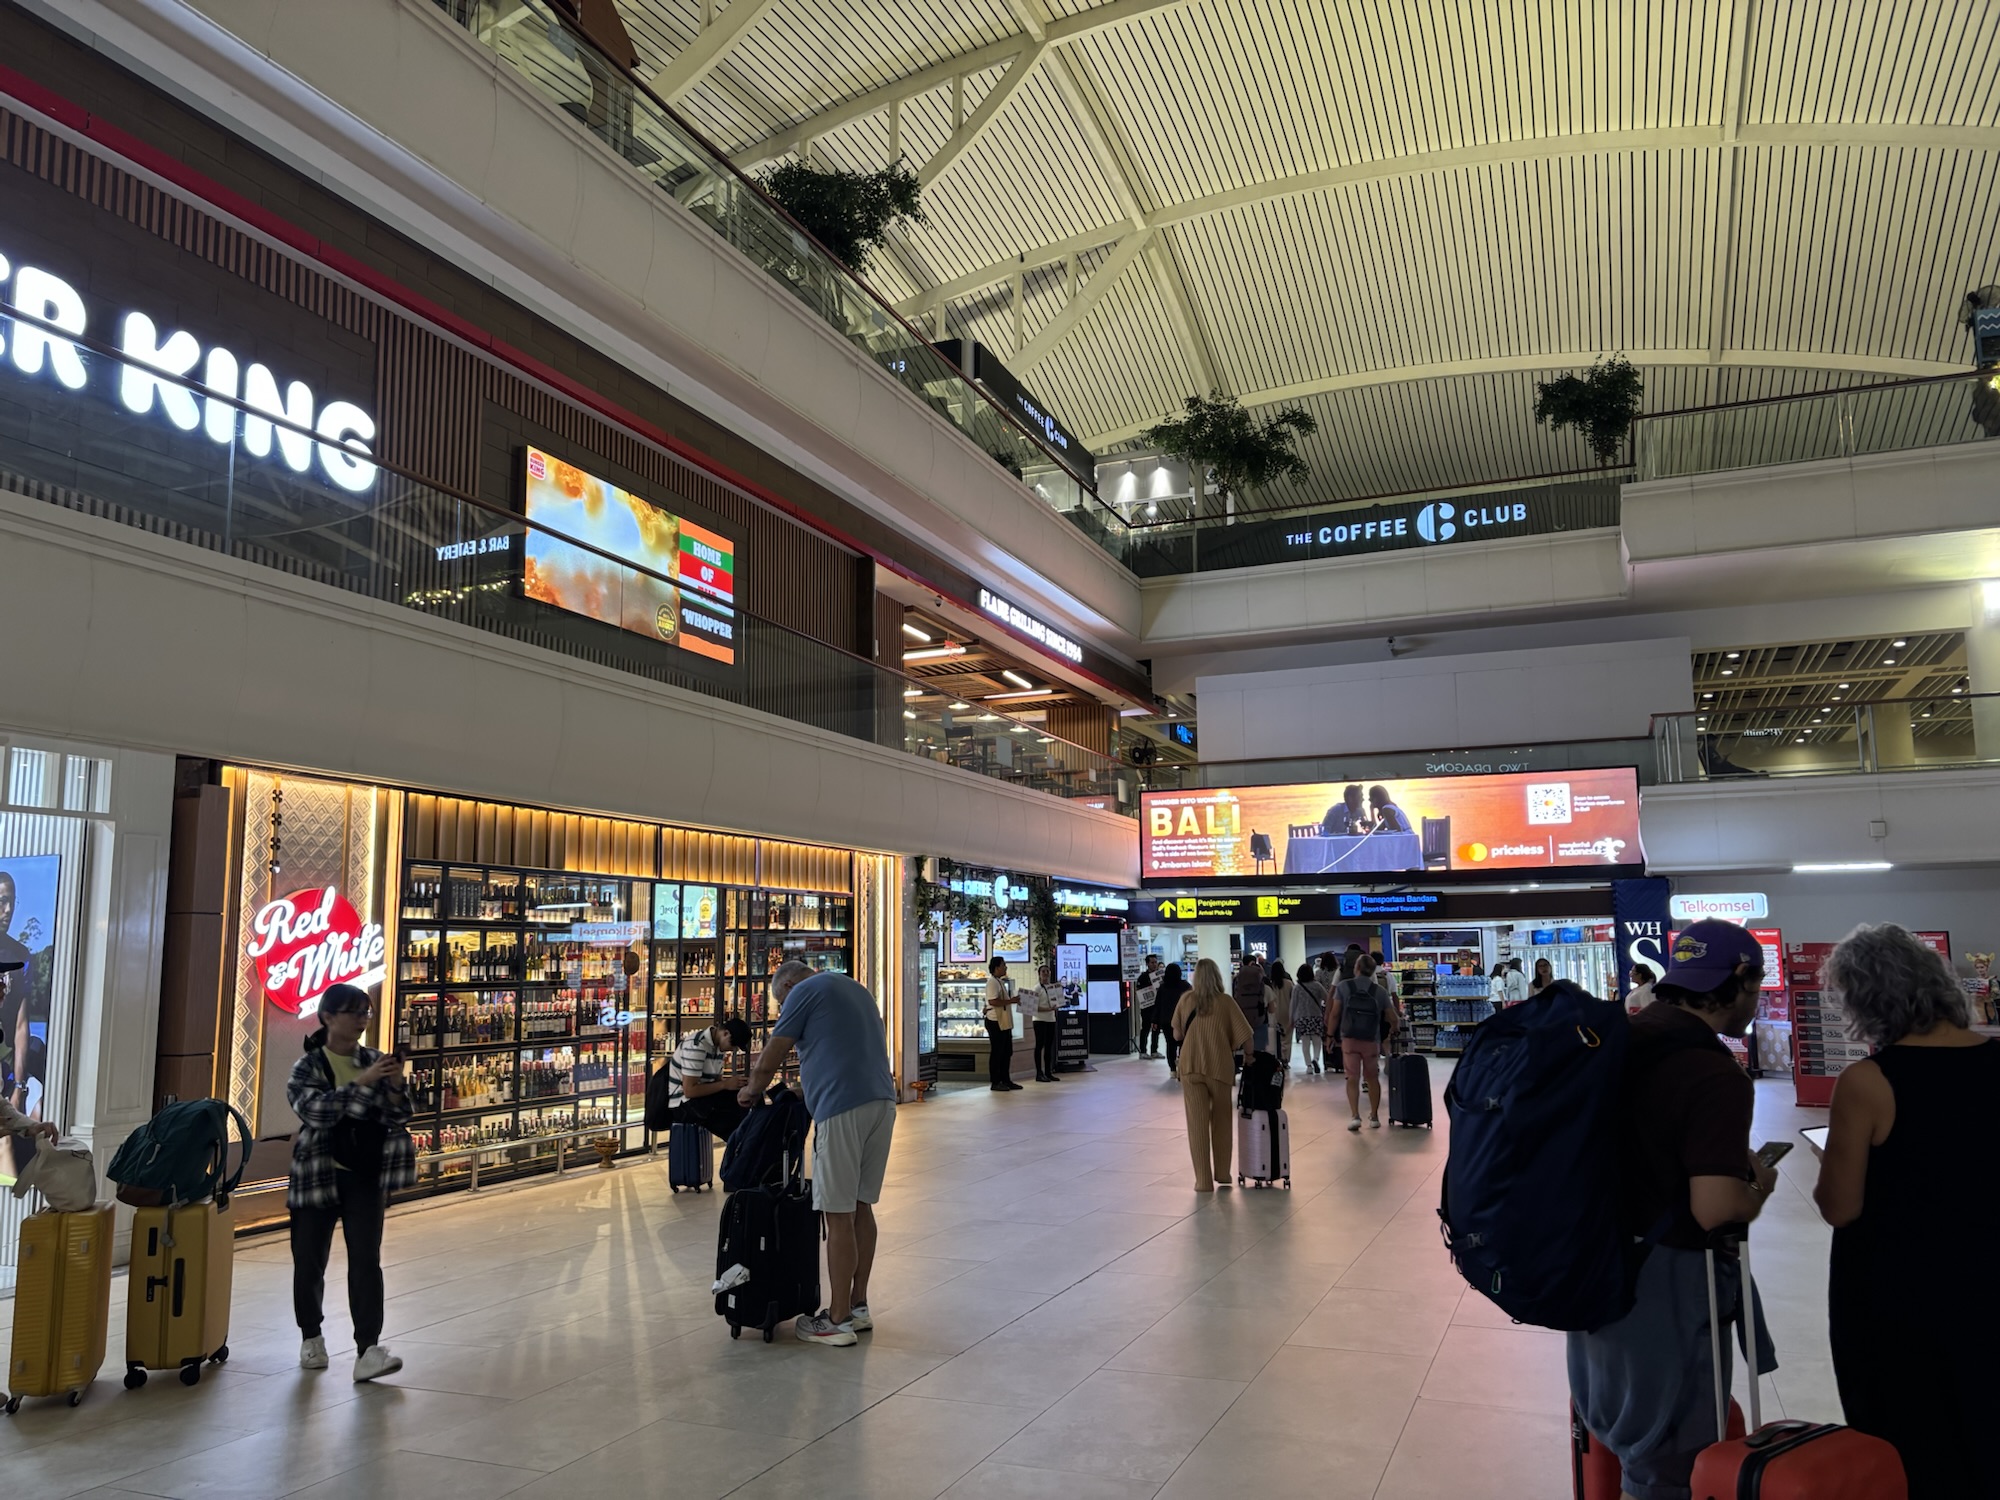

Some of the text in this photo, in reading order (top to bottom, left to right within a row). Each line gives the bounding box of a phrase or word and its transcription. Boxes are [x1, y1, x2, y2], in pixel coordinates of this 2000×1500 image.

[0, 253, 378, 491] R KING
[1024, 400, 1045, 428] COFFEE
[530, 464, 545, 476] KING
[1286, 532, 1313, 546] THE
[1318, 517, 1408, 545] COFFEE
[1464, 503, 1527, 528] CLUB
[693, 541, 722, 567] HOME
[700, 566, 714, 583] OF
[682, 608, 733, 640] WHOPPER
[1150, 804, 1240, 837] BALI
[1491, 844, 1544, 858] priceless
[1198, 894, 1438, 907] Penjemputan Keluar Transportasi Bandara
[1679, 898, 1755, 913] Telkomsel
[248, 886, 336, 957] Red
[1624, 922, 1662, 936] WH
[266, 922, 385, 997] & White
